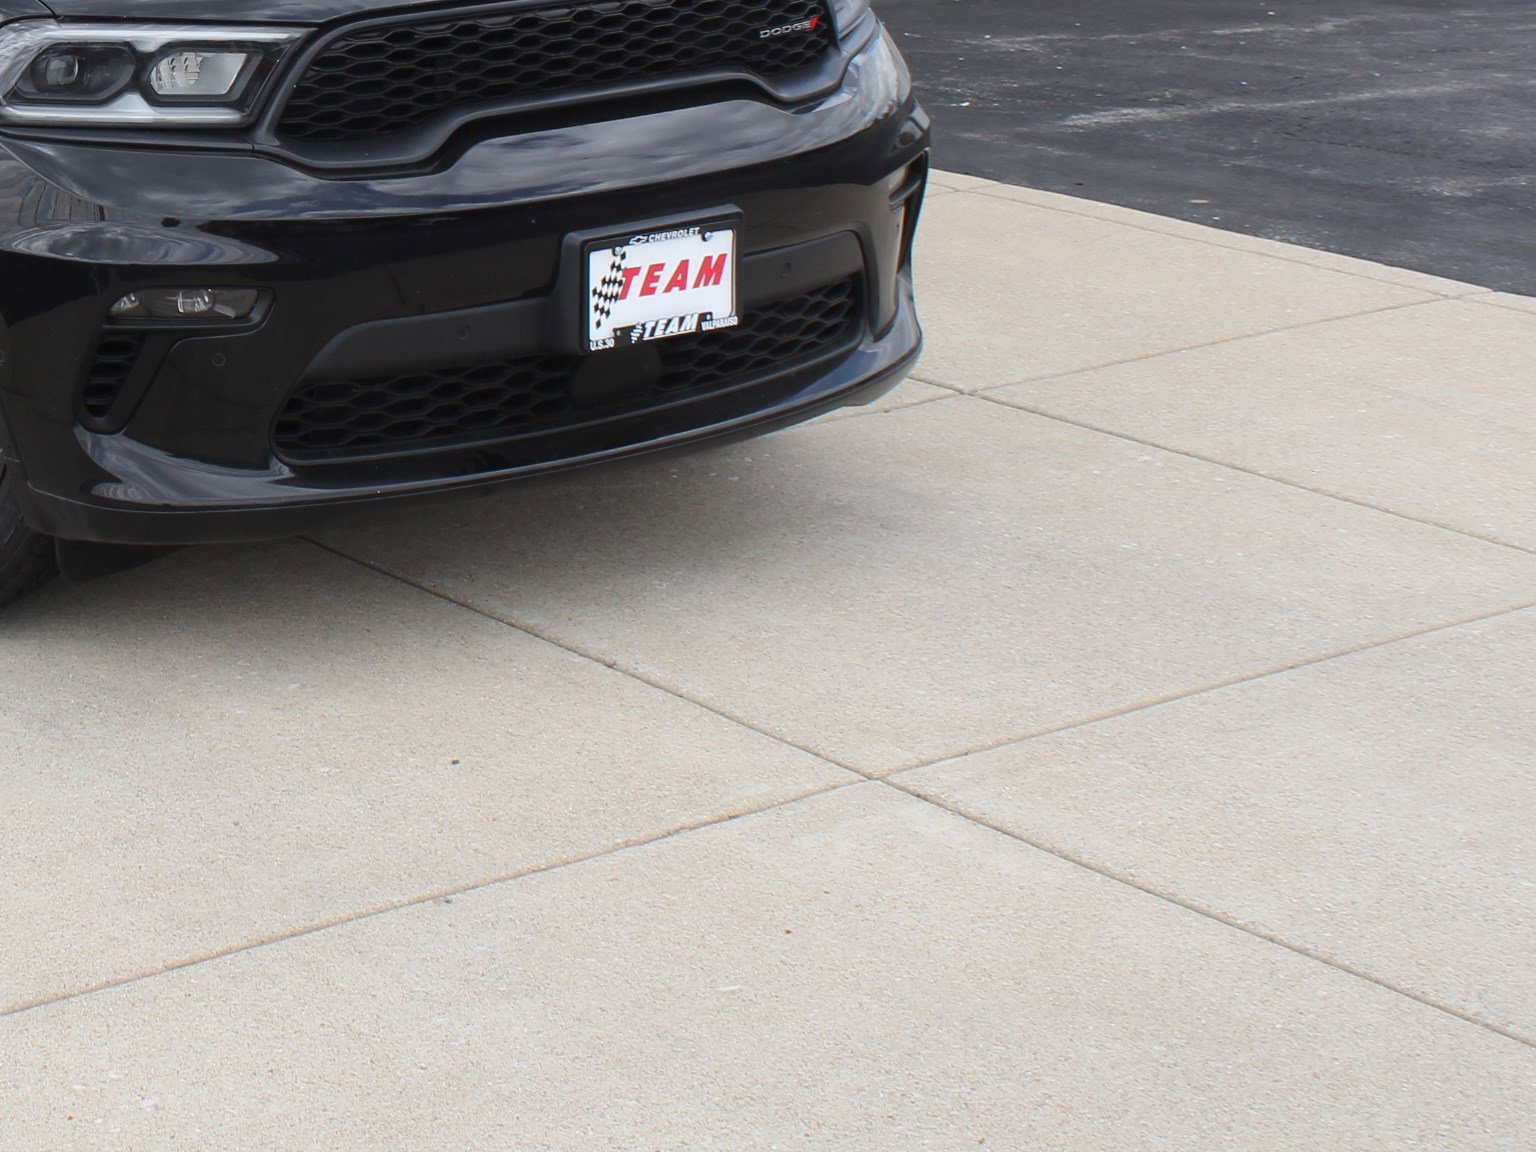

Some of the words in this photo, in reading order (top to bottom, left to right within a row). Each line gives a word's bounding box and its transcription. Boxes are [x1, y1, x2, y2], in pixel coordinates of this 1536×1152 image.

[760, 19, 811, 38] DODGE
[648, 227, 700, 243] CHEVROLET
[619, 253, 728, 300] TEAM
[642, 313, 700, 339] TEAM
[701, 316, 738, 331] VALPARAISO
